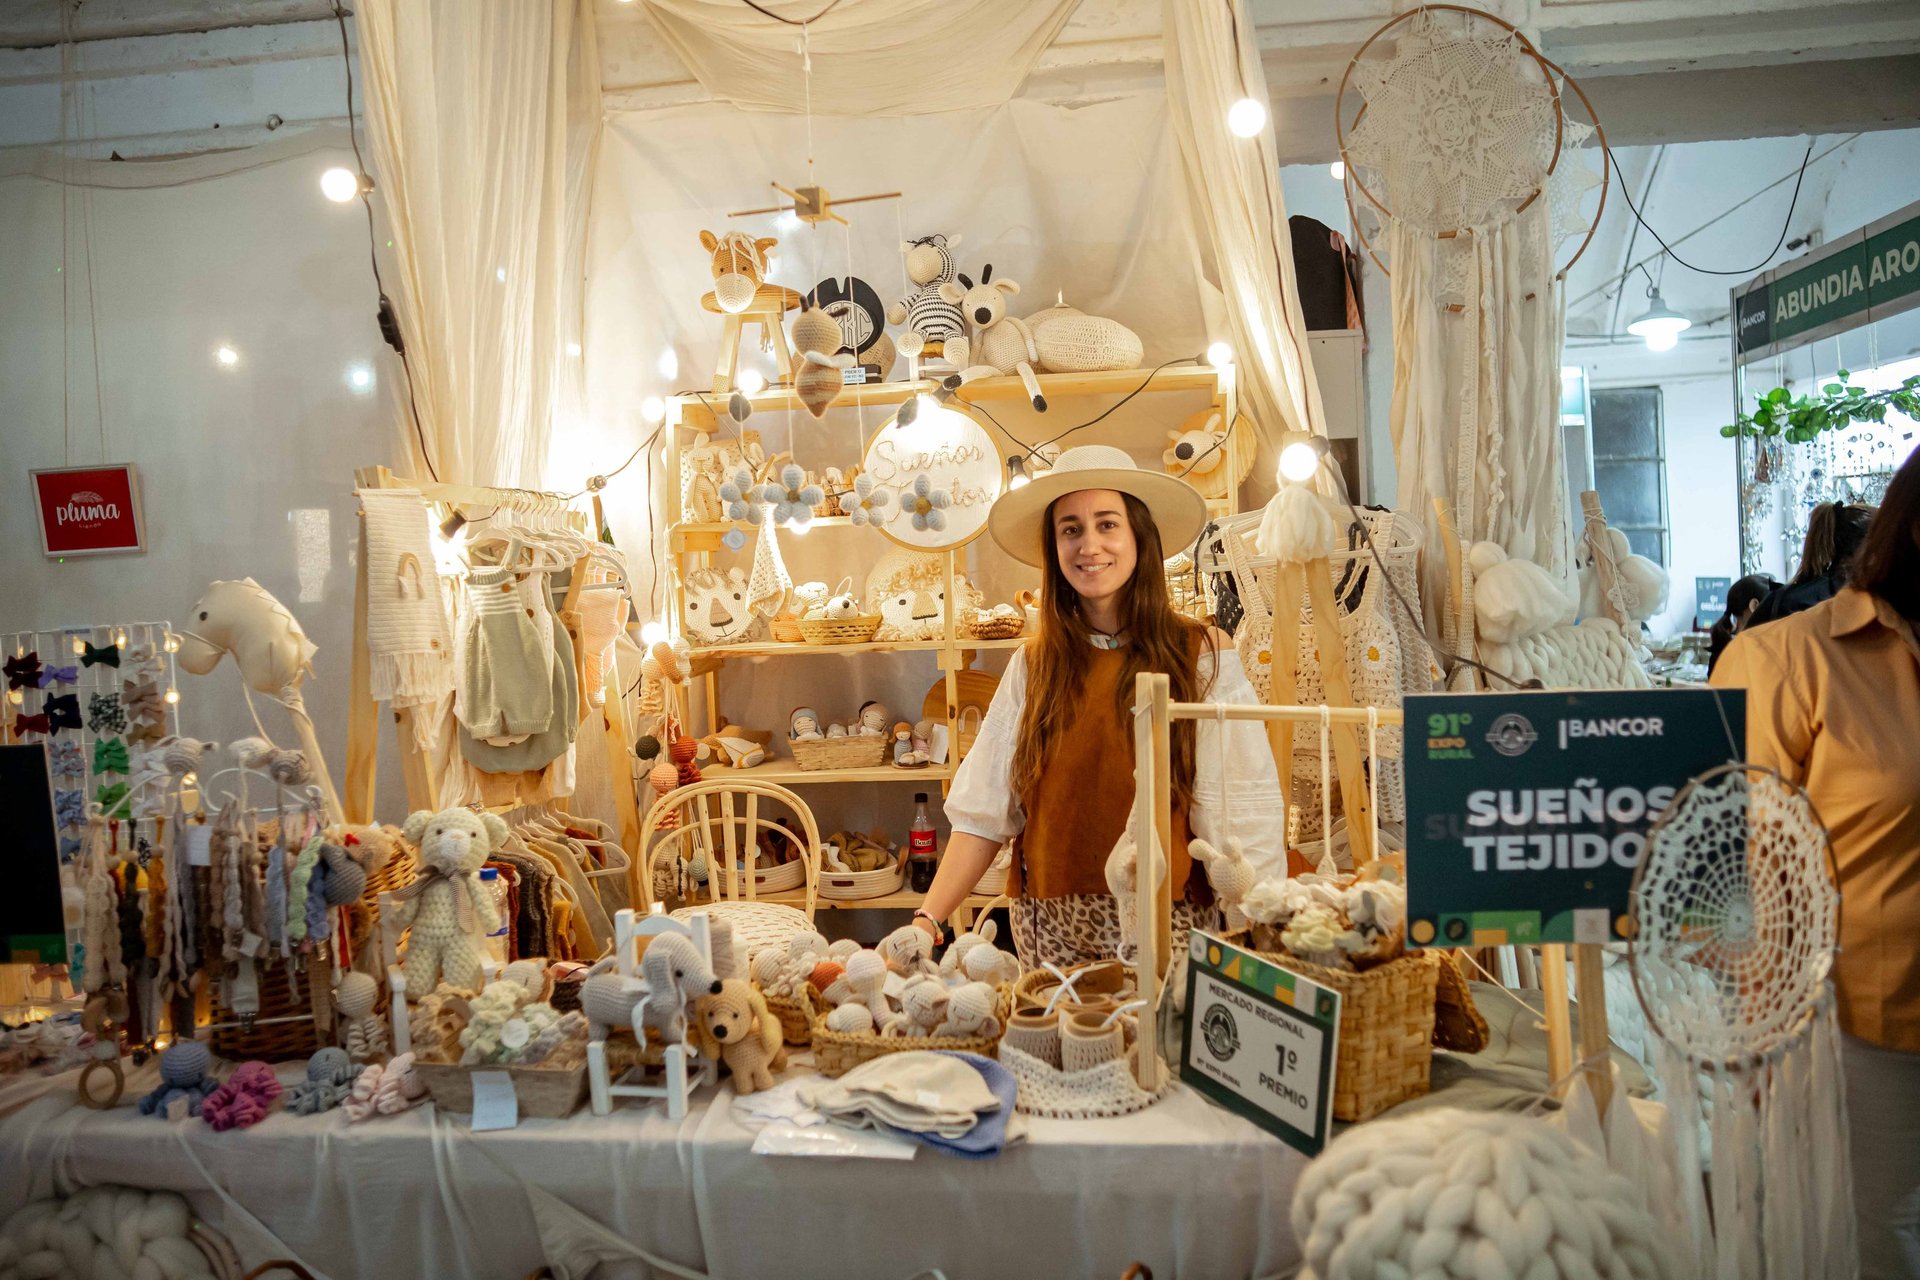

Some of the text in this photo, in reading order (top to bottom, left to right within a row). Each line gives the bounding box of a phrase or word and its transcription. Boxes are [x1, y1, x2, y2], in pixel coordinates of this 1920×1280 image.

[1775, 240, 1920, 324] ABUNDIA ARO
[1742, 310, 1766, 328] BANCOR
[872, 440, 984, 482] Sueños
[56, 502, 121, 526] pluma
[1427, 737, 1466, 748] EXPO
[1568, 718, 1664, 738] BANCOR
[1428, 749, 1474, 760] RURAL
[1466, 778, 1679, 827] SUEÑOS
[1463, 831, 1650, 872] TEJIDO
[1208, 983, 1253, 1014] MERCADO
[1255, 1005, 1304, 1039] REGIONAL
[1259, 1072, 1308, 1110] PREMIO
